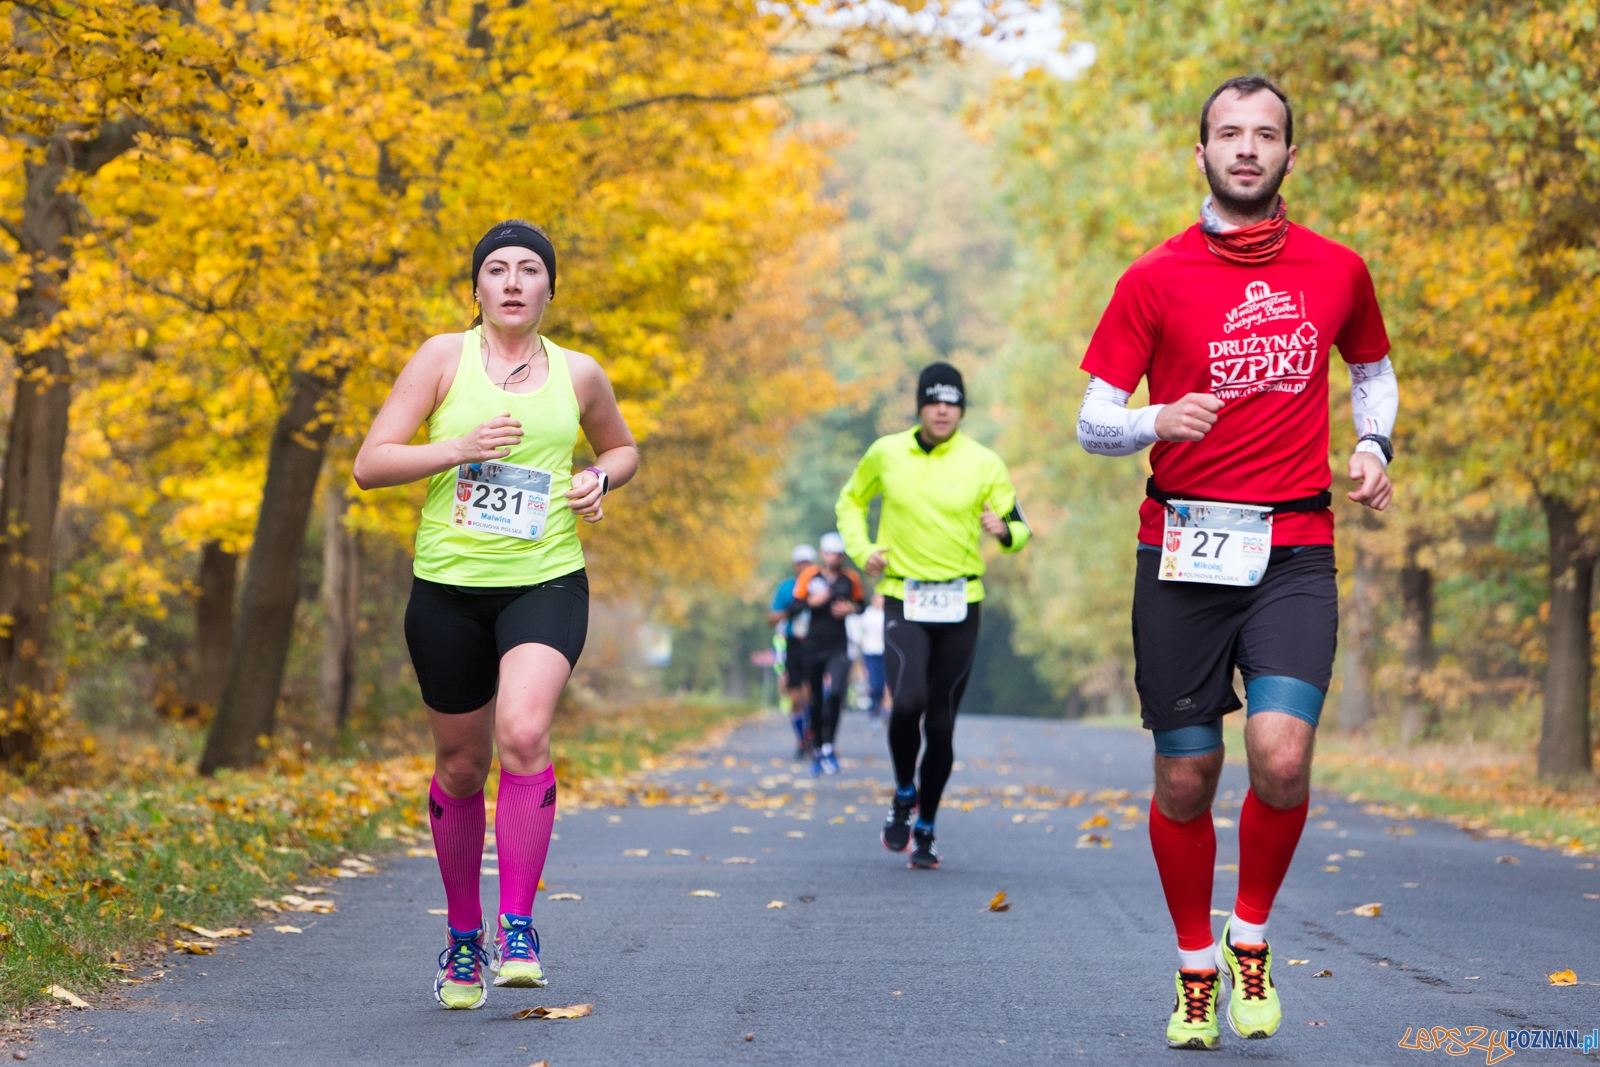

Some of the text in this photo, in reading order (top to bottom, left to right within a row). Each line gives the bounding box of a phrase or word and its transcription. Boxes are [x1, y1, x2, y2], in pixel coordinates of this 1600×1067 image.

[1208, 333, 1302, 358] DRUŻYNA
[1209, 349, 1318, 388] SZPIKU
[1095, 422, 1124, 438] GÓRSKI
[472, 484, 523, 515] 231
[480, 512, 511, 524] Malwina
[472, 521, 523, 535] POLINOVA POLSKA
[1191, 530, 1230, 559] 27
[1193, 561, 1223, 573] Mikołaj
[1214, 574, 1239, 582] POLSKA
[918, 592, 949, 608] 243
